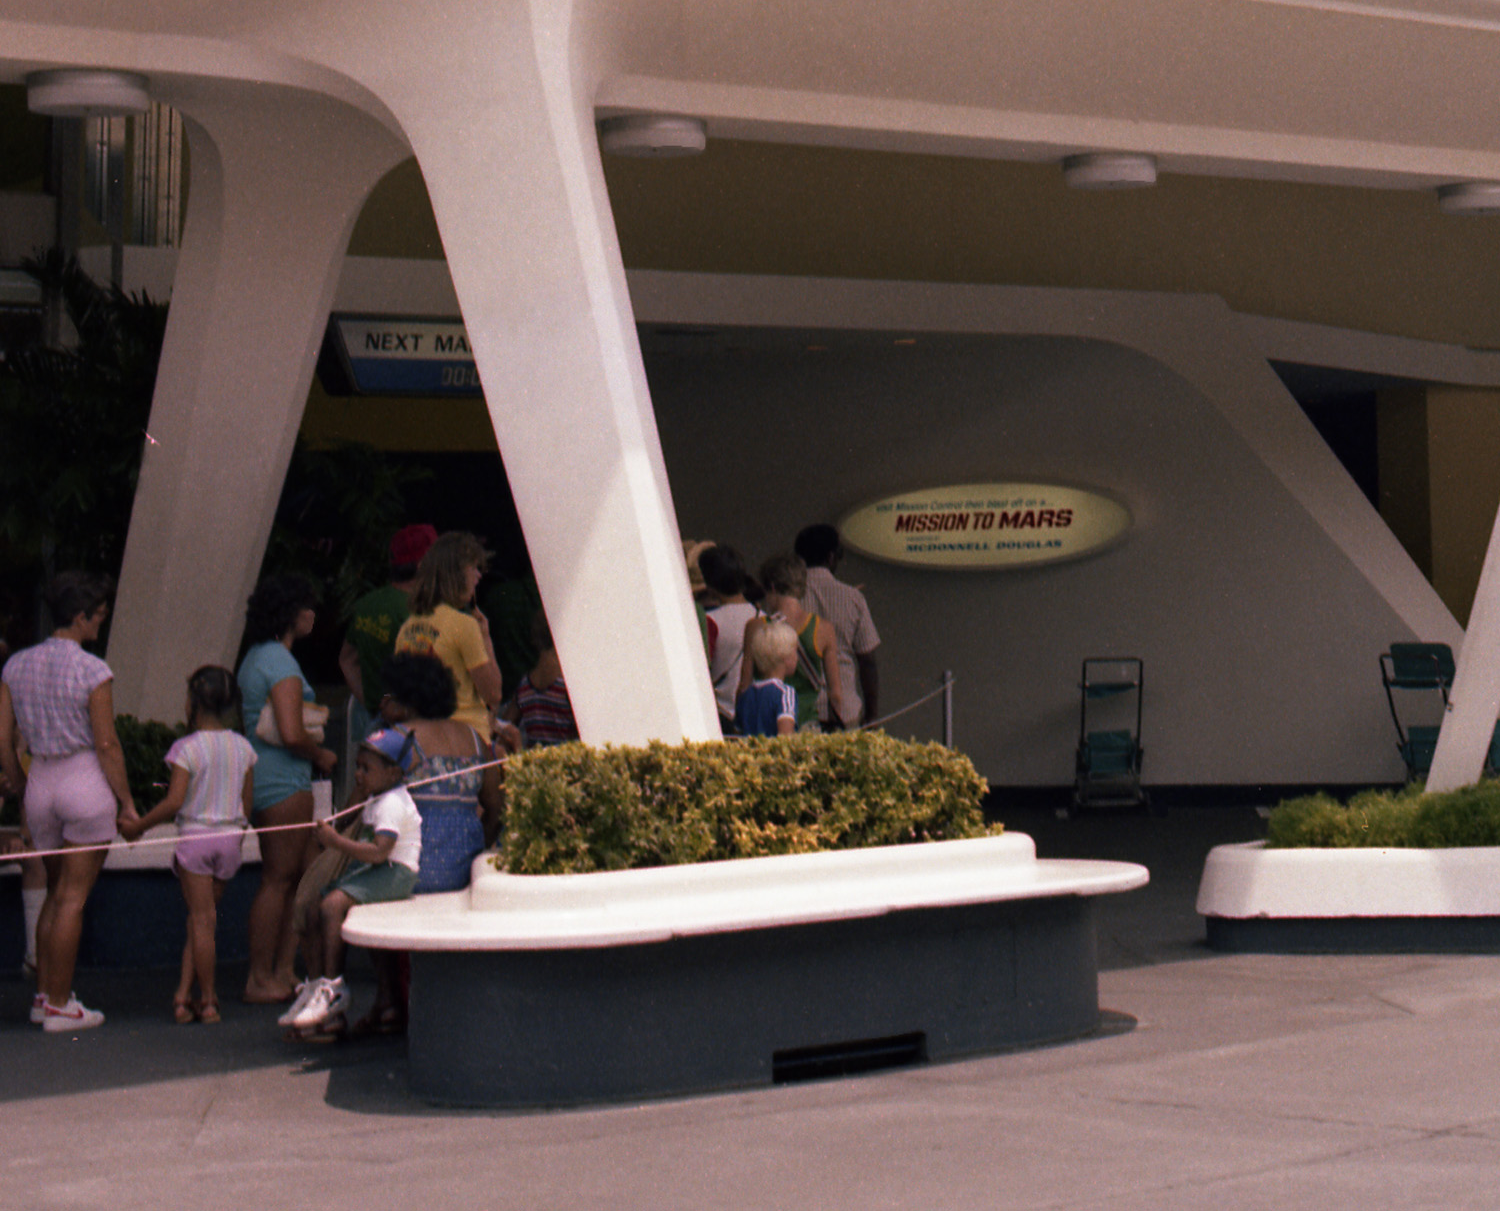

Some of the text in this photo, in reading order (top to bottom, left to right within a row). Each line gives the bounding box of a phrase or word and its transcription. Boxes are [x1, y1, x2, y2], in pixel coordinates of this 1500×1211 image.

[365, 332, 473, 353] NEXT MA
[895, 508, 1073, 533] MISSION TO MARS
[905, 539, 1062, 552] MCDONNELL DOUGLAS
